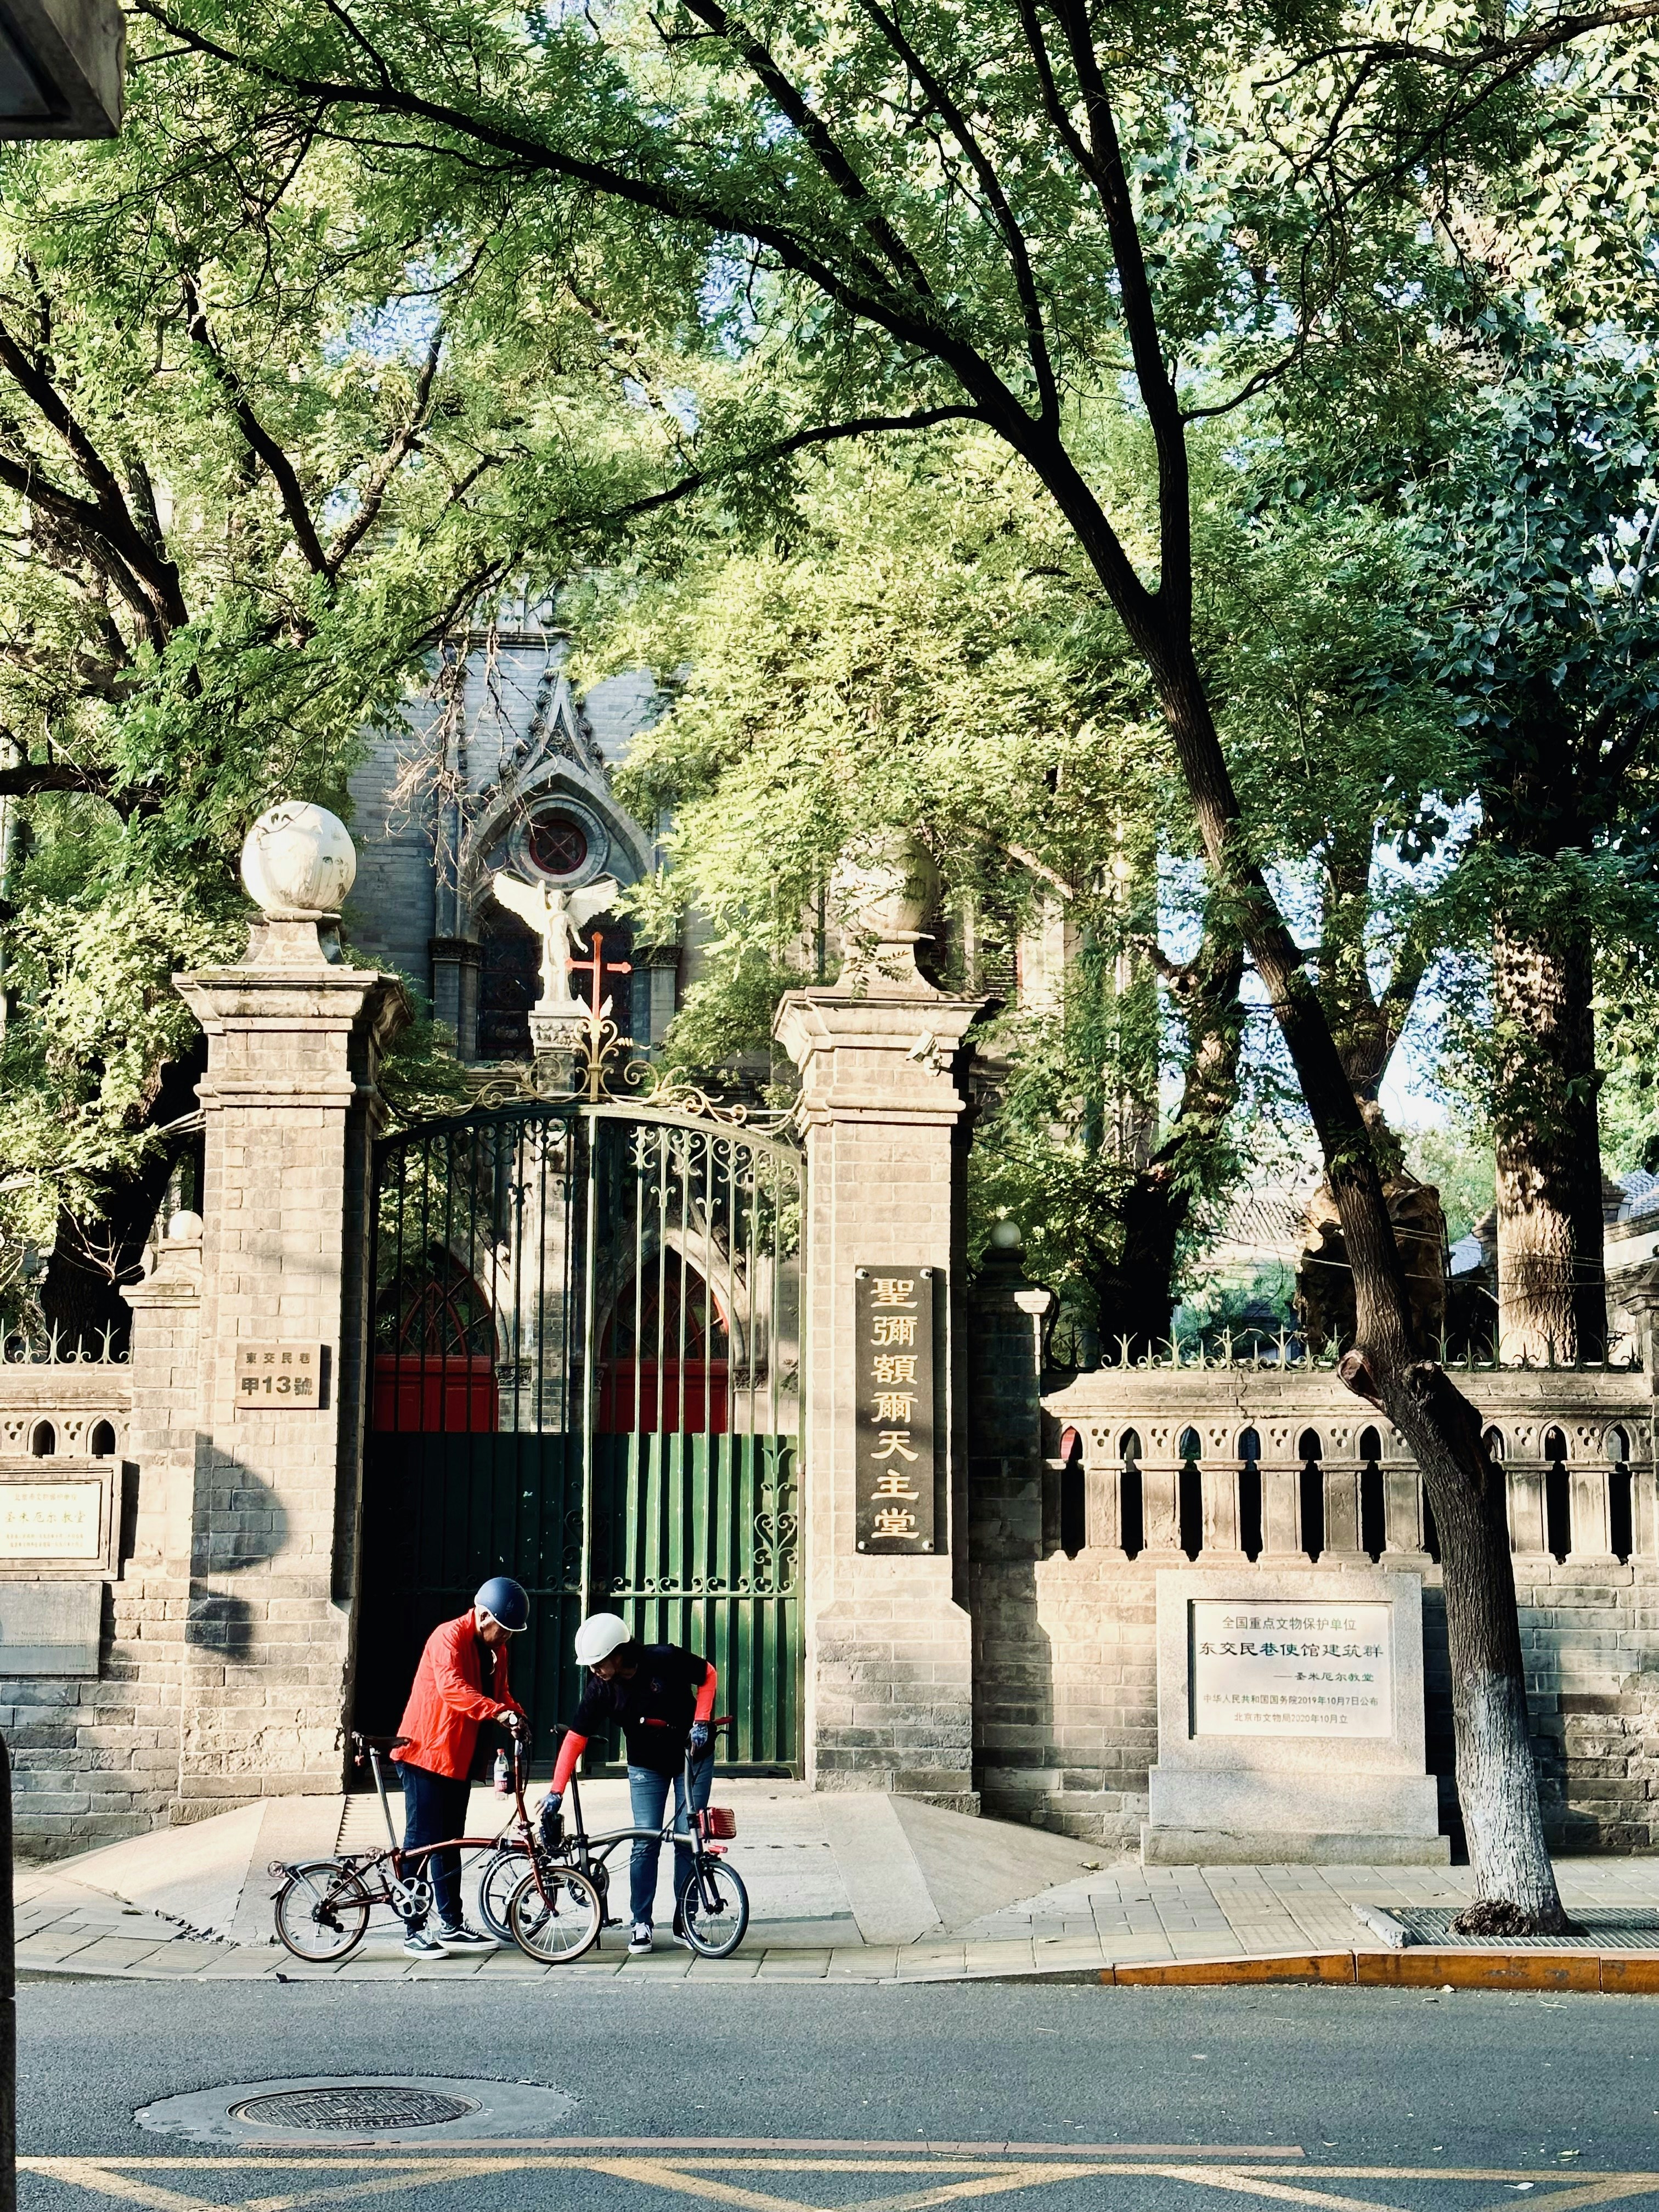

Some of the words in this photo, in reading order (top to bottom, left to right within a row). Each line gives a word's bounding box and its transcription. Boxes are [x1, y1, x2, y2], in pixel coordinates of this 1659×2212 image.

[246, 1352, 311, 1364] 東交民巷
[241, 1375, 313, 1396] 甲13號
[871, 1278, 919, 1539] 聖彌額爾天主堂
[1222, 1616, 1357, 1631] 全国重点文物保护单位
[1198, 1641, 1384, 1658] 东交民巷使馆建筑群
[1203, 1694, 1379, 1707] 中华人民共和国国务院2019年10月7日公布
[1234, 1713, 1348, 1724] 北京市文物局2020年10月立
